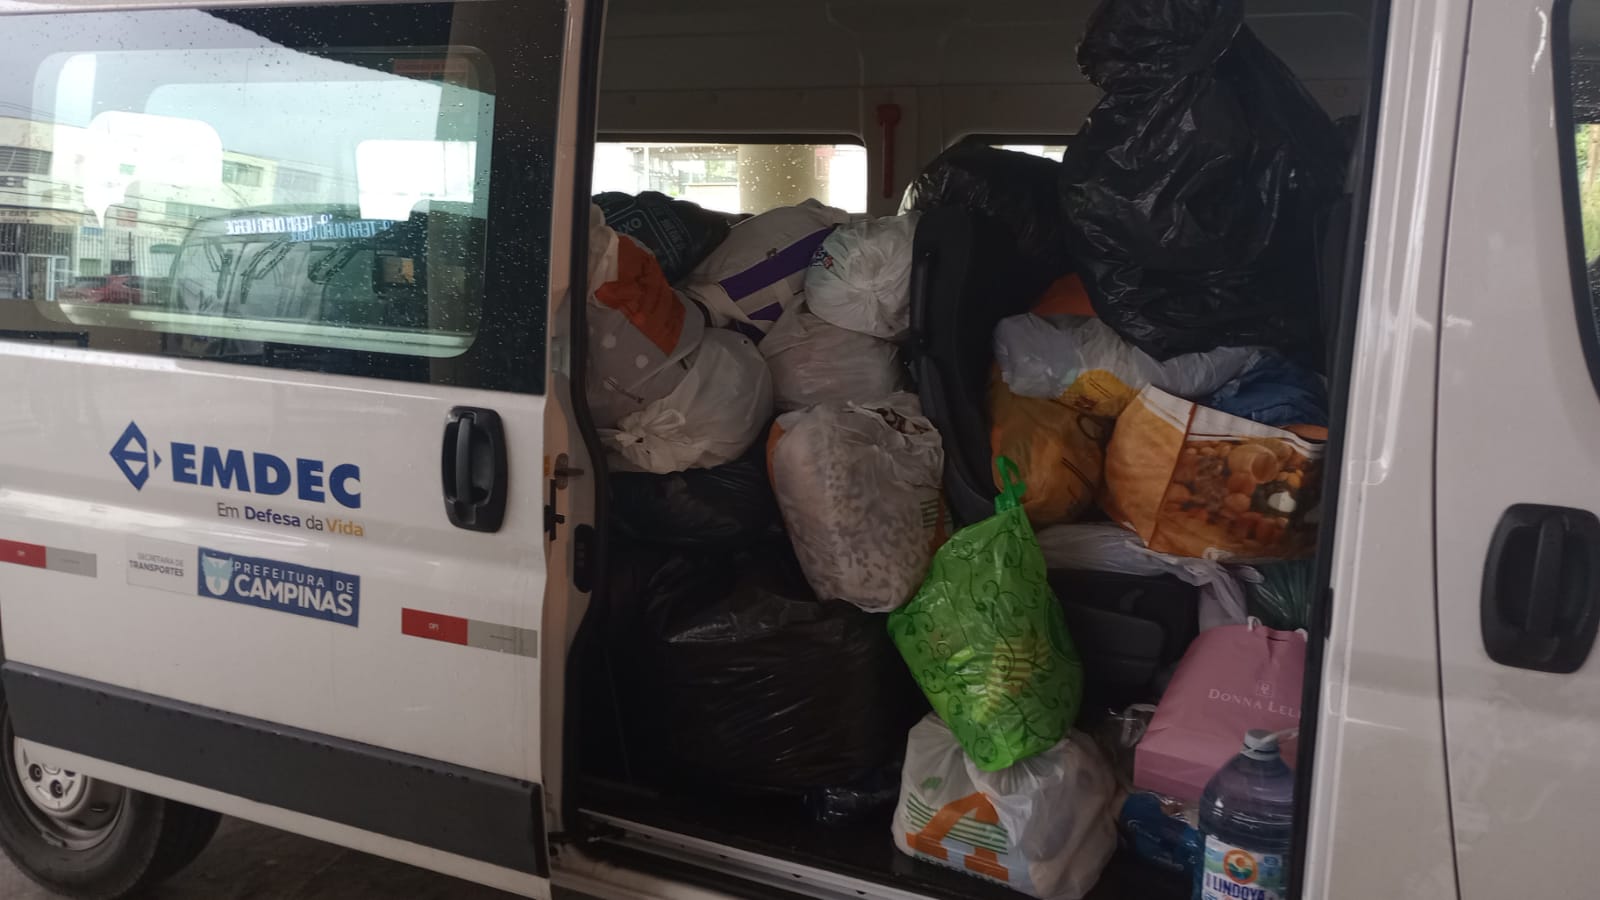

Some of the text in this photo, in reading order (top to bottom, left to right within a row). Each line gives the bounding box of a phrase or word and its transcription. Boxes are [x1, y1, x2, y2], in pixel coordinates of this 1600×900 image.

[170, 442, 361, 509] EMDEC
[217, 502, 363, 537] Em Defesa da Vida
[128, 559, 184, 577] TRANSPORTES
[233, 560, 354, 594] PREFEITURA DE
[233, 574, 353, 617] CAMPINAS
[1208, 688, 1263, 710] DONNA
